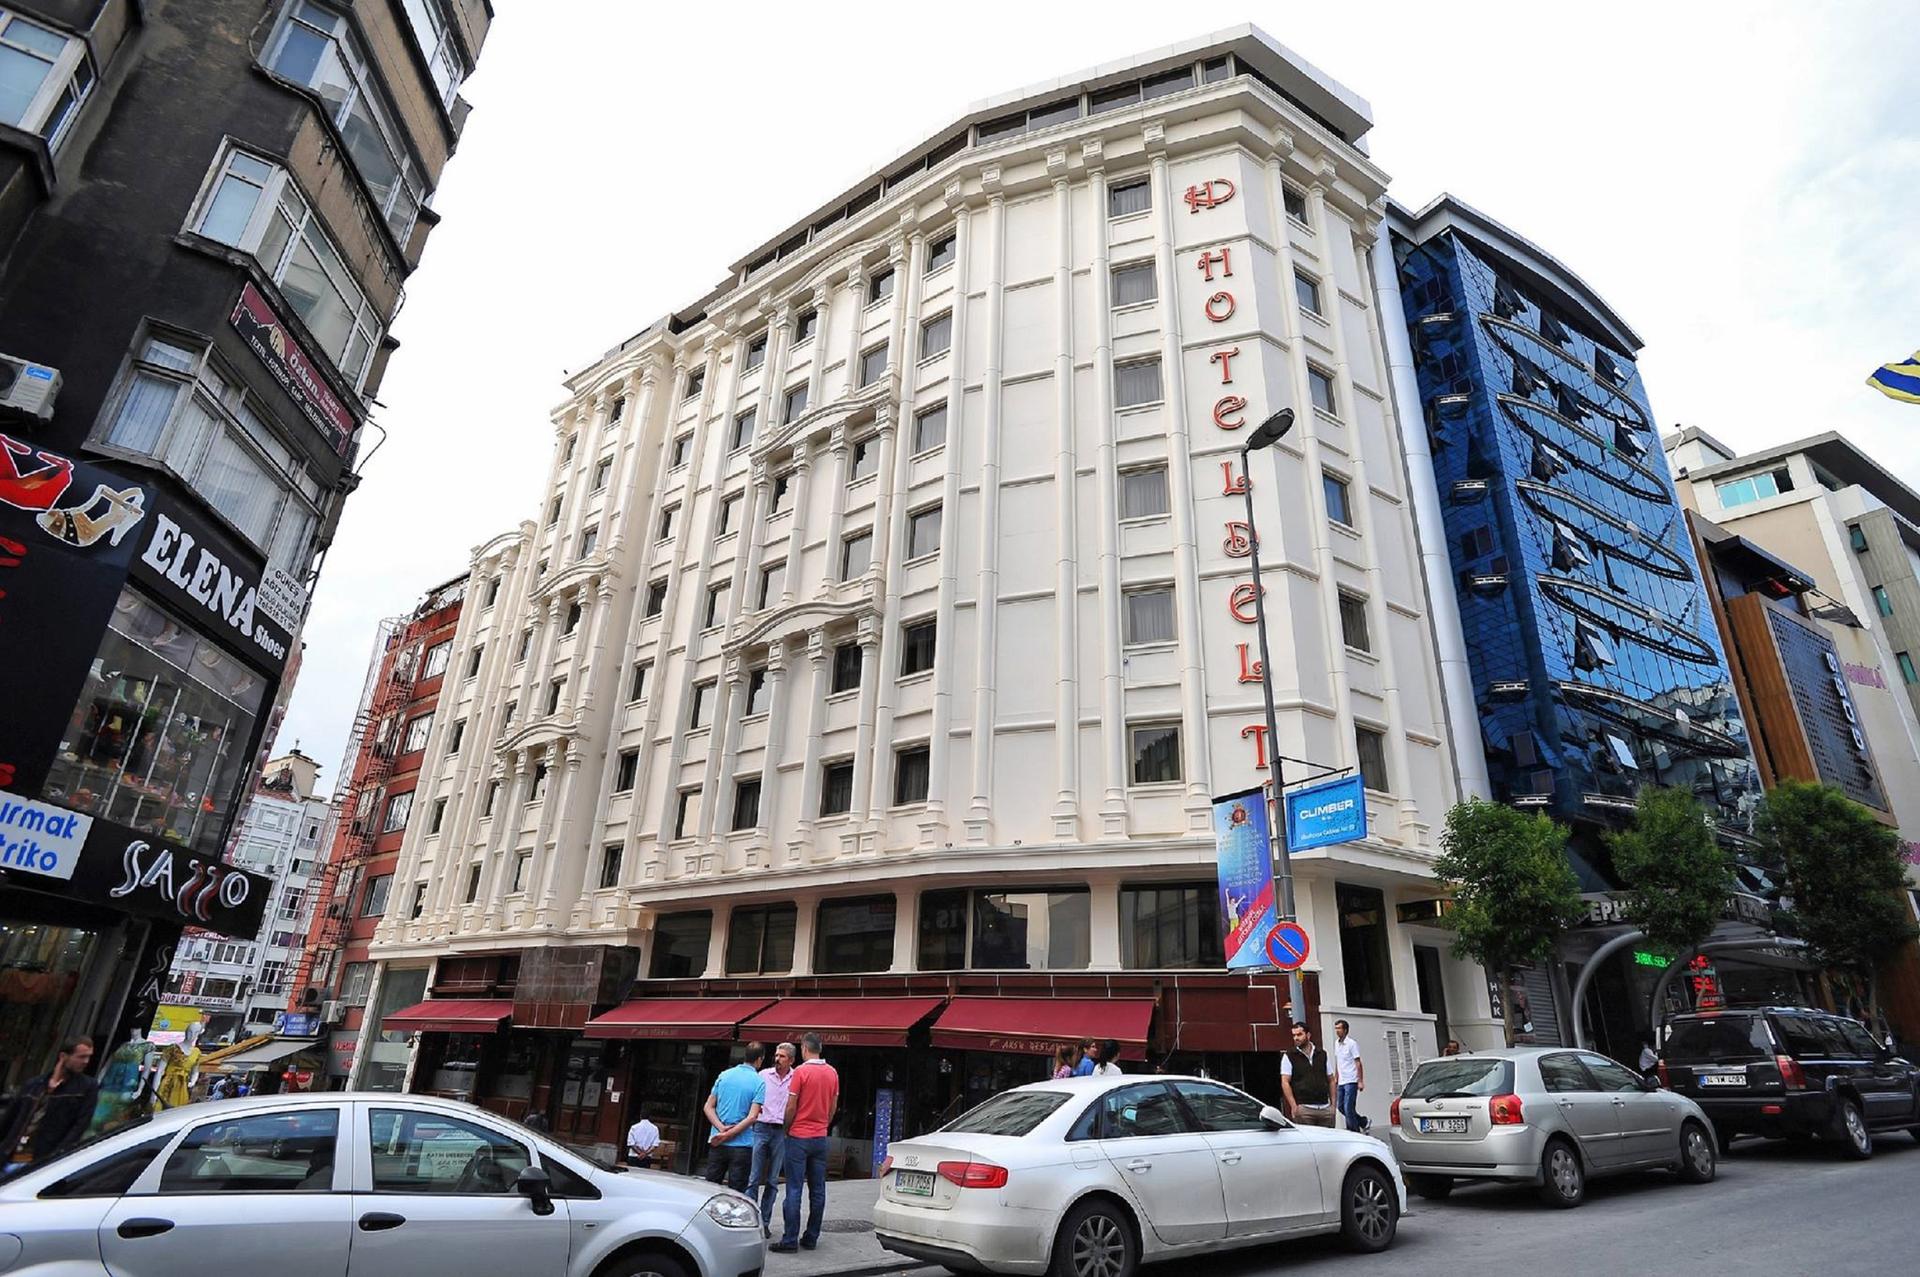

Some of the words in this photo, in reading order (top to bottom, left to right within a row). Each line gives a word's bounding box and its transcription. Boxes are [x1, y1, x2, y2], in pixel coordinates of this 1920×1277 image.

[141, 513, 256, 637] ELENA
[254, 625, 285, 660] Shoes
[1425, 1119, 1434, 1130] 34
